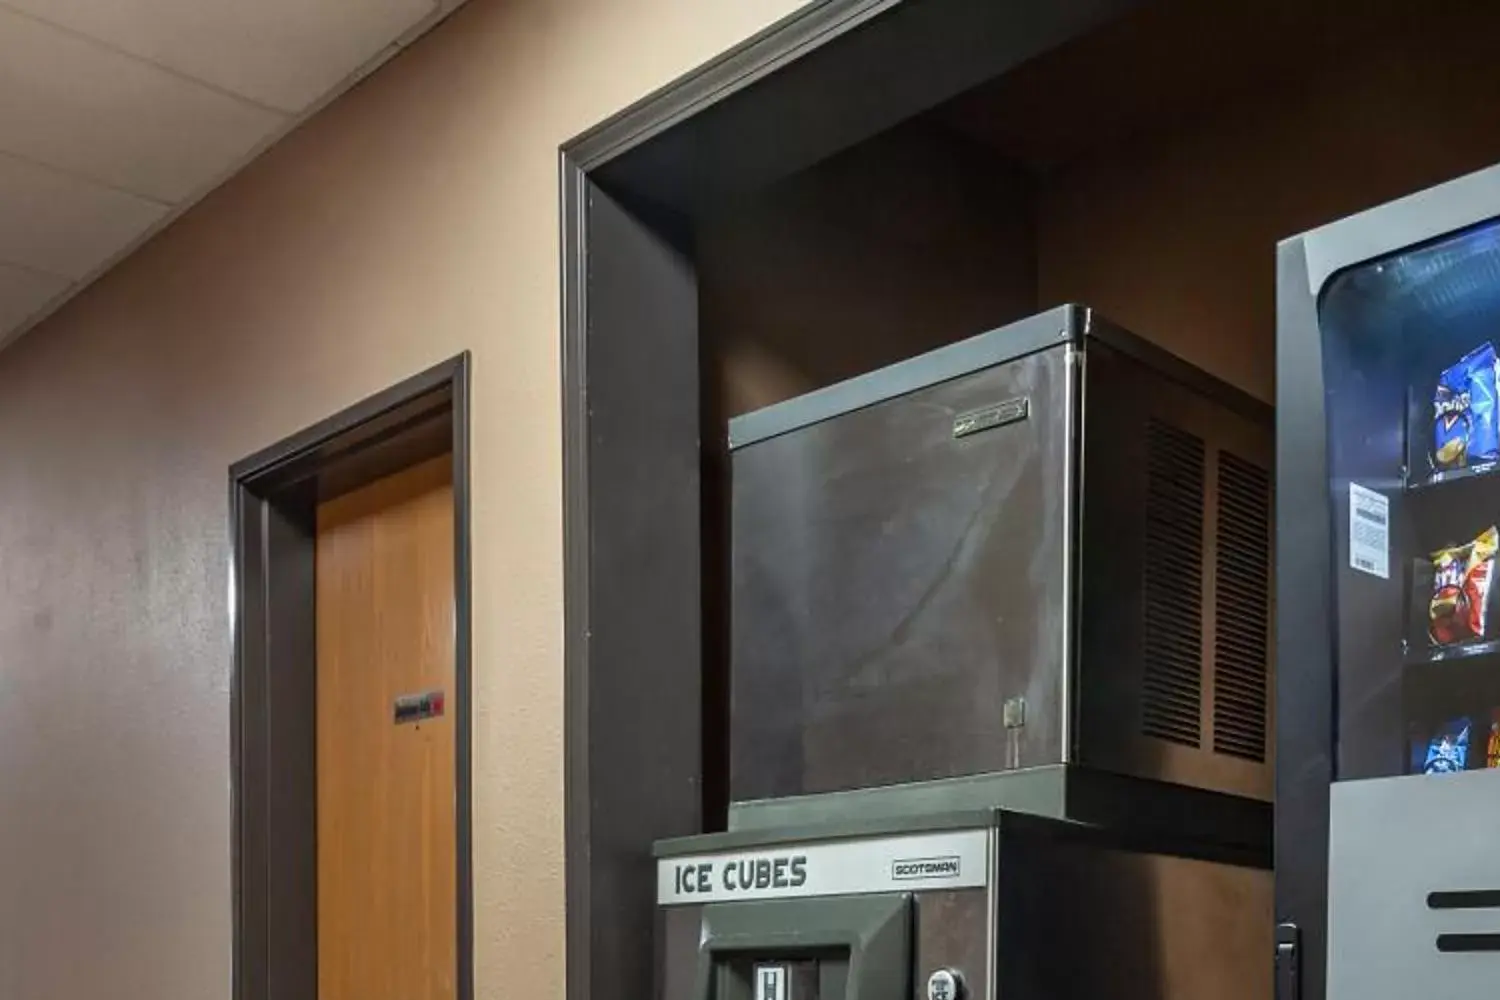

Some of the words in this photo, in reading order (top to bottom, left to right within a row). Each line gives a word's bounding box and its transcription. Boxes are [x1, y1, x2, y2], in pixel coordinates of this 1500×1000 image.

[675, 864, 712, 894] ICE
[722, 856, 807, 890] CUBES
[895, 861, 958, 876] SCOTSMAN
